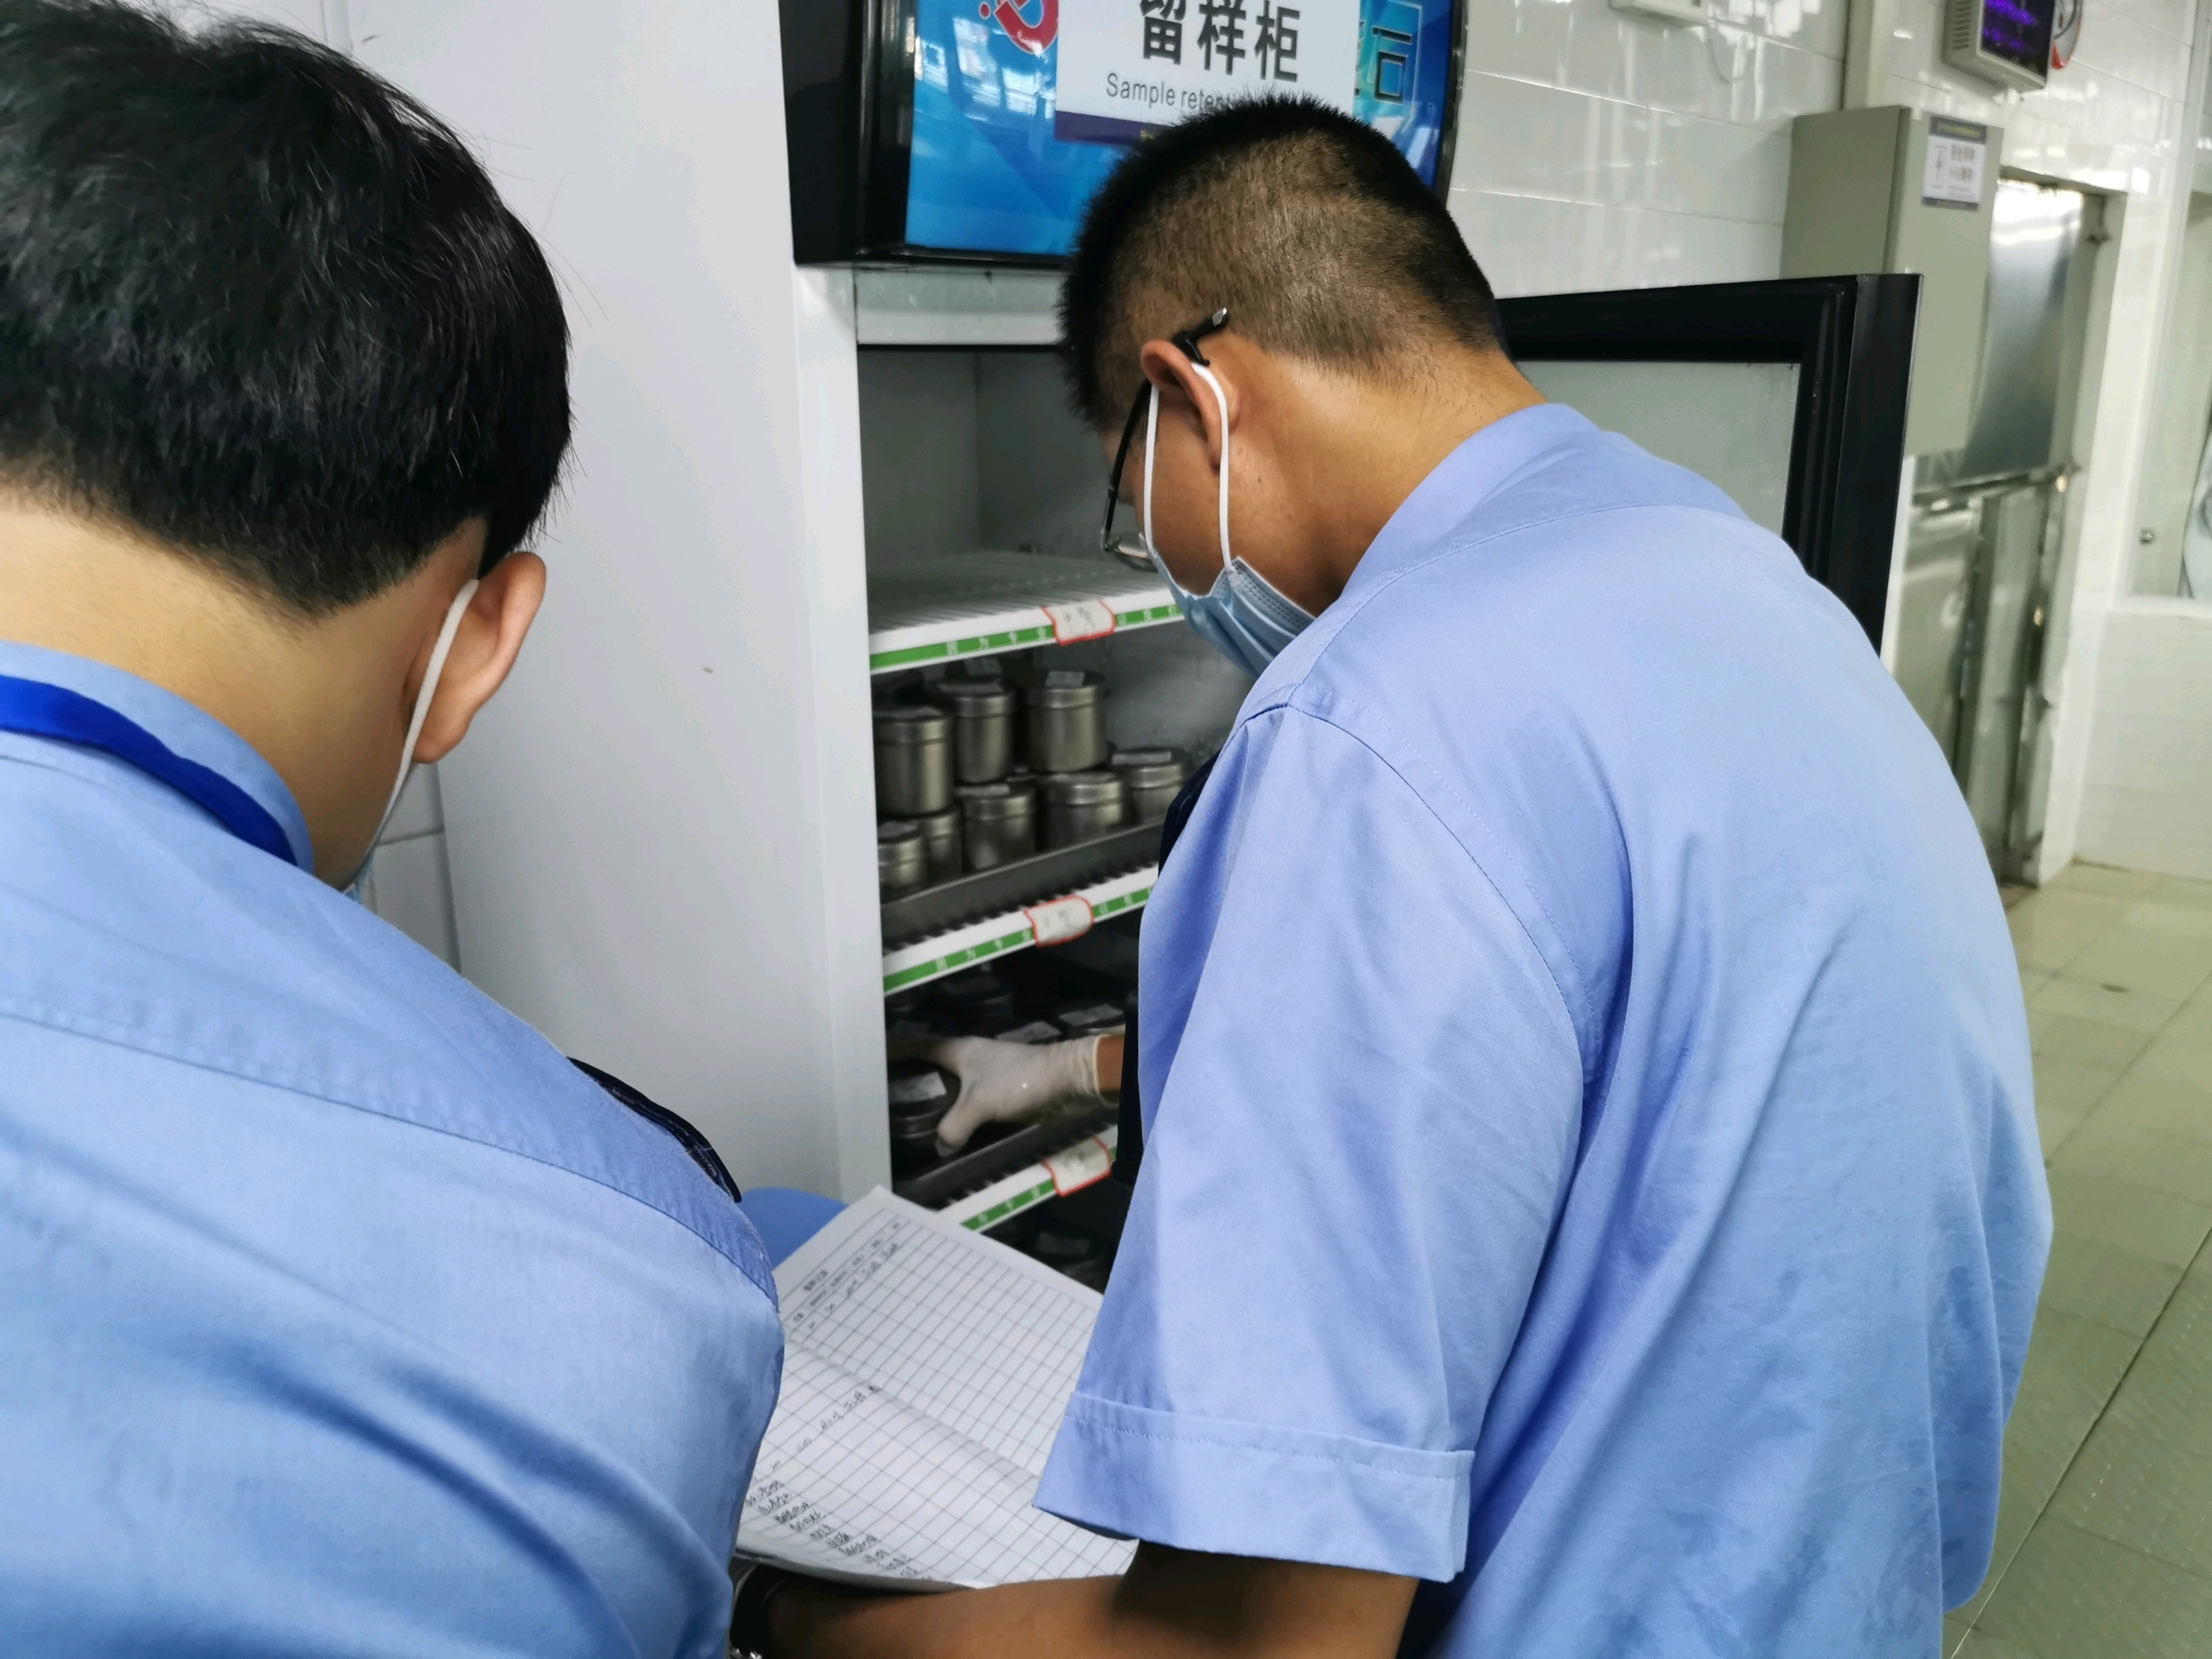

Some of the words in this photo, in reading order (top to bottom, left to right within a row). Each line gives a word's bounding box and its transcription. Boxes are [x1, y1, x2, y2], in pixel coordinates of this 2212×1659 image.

[1139, 0, 1300, 83] 留样柜
[1105, 72, 1176, 110] Sample
